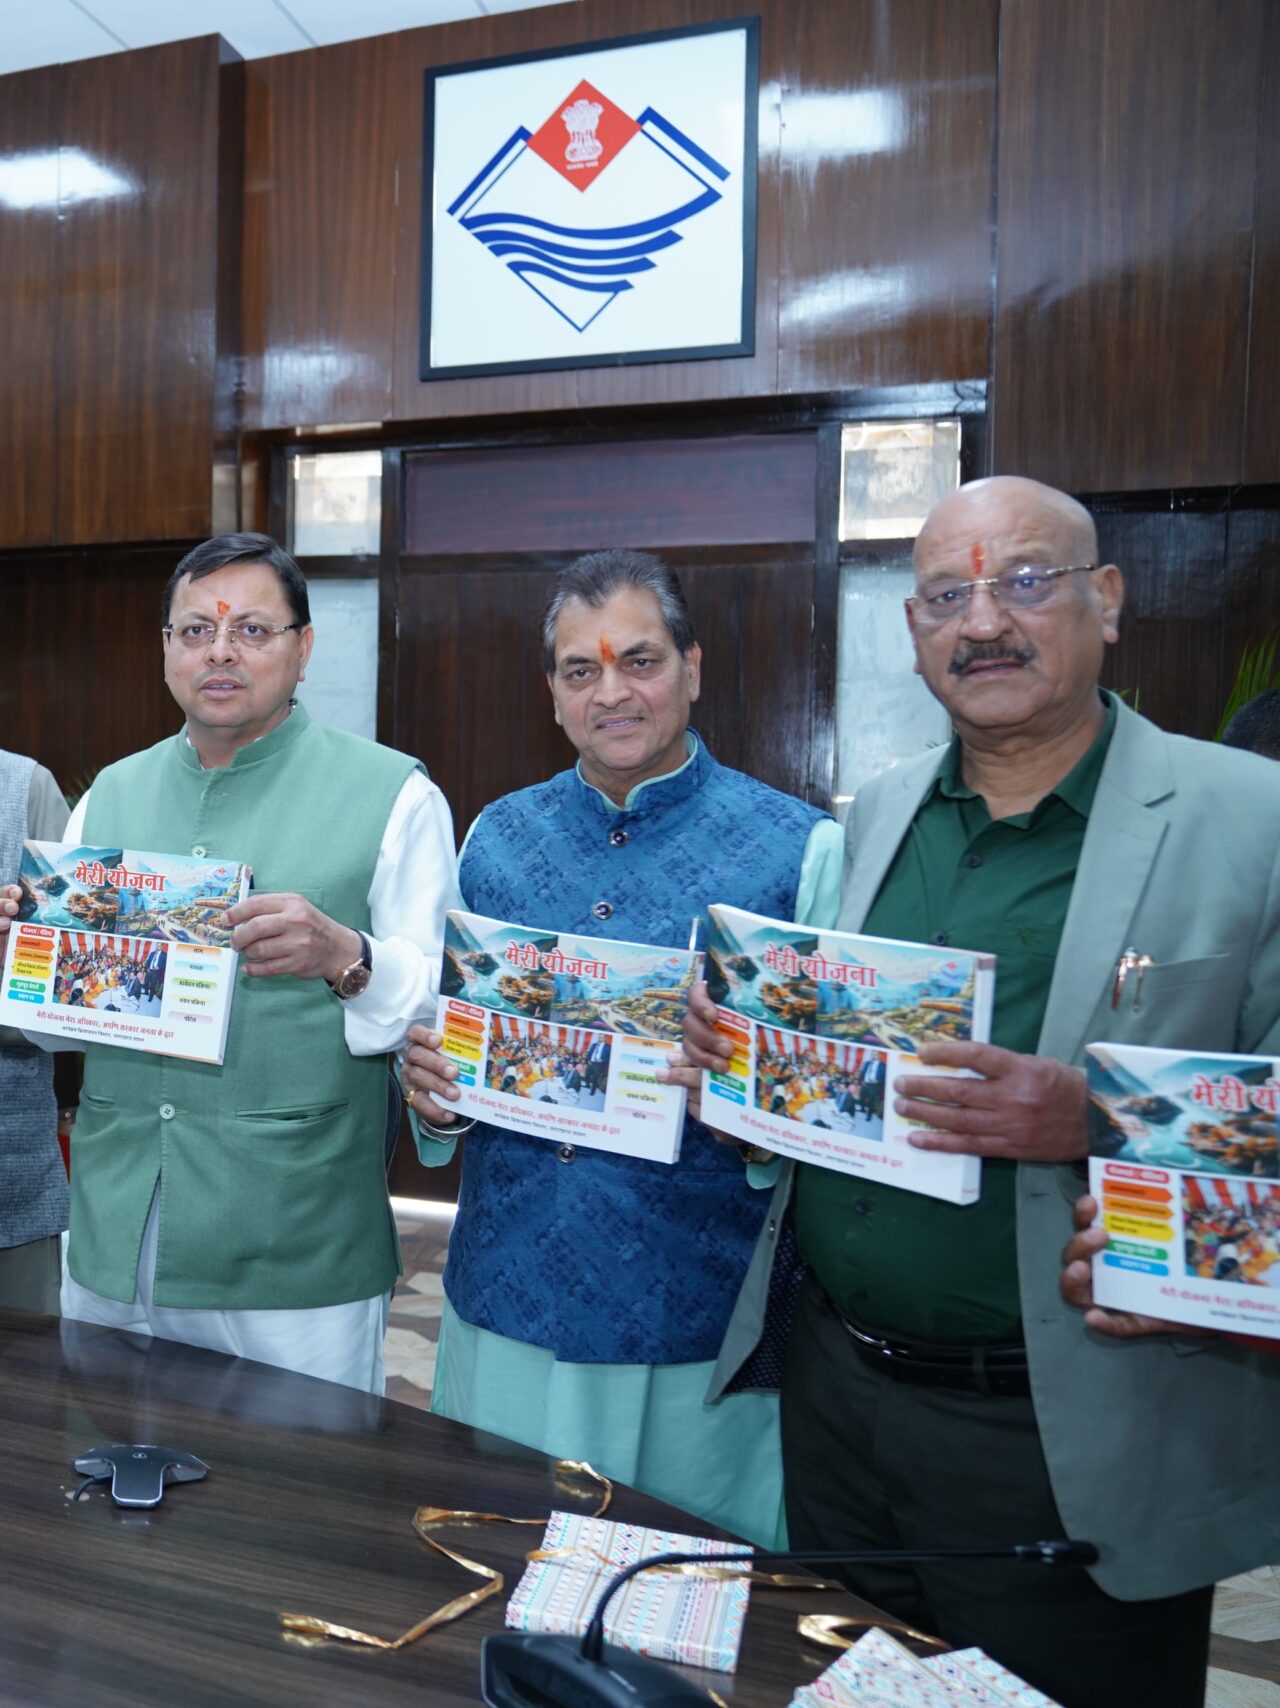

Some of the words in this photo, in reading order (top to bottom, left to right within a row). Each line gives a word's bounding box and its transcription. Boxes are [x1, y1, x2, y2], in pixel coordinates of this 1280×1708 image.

[75, 861, 105, 885] मेरी
[108, 865, 166, 891] योजना
[507, 940, 538, 968] मेरी
[543, 948, 608, 979] योजना
[764, 942, 800, 977] मेरी
[801, 952, 877, 987] योजना
[1192, 1076, 1248, 1110] मेरी
